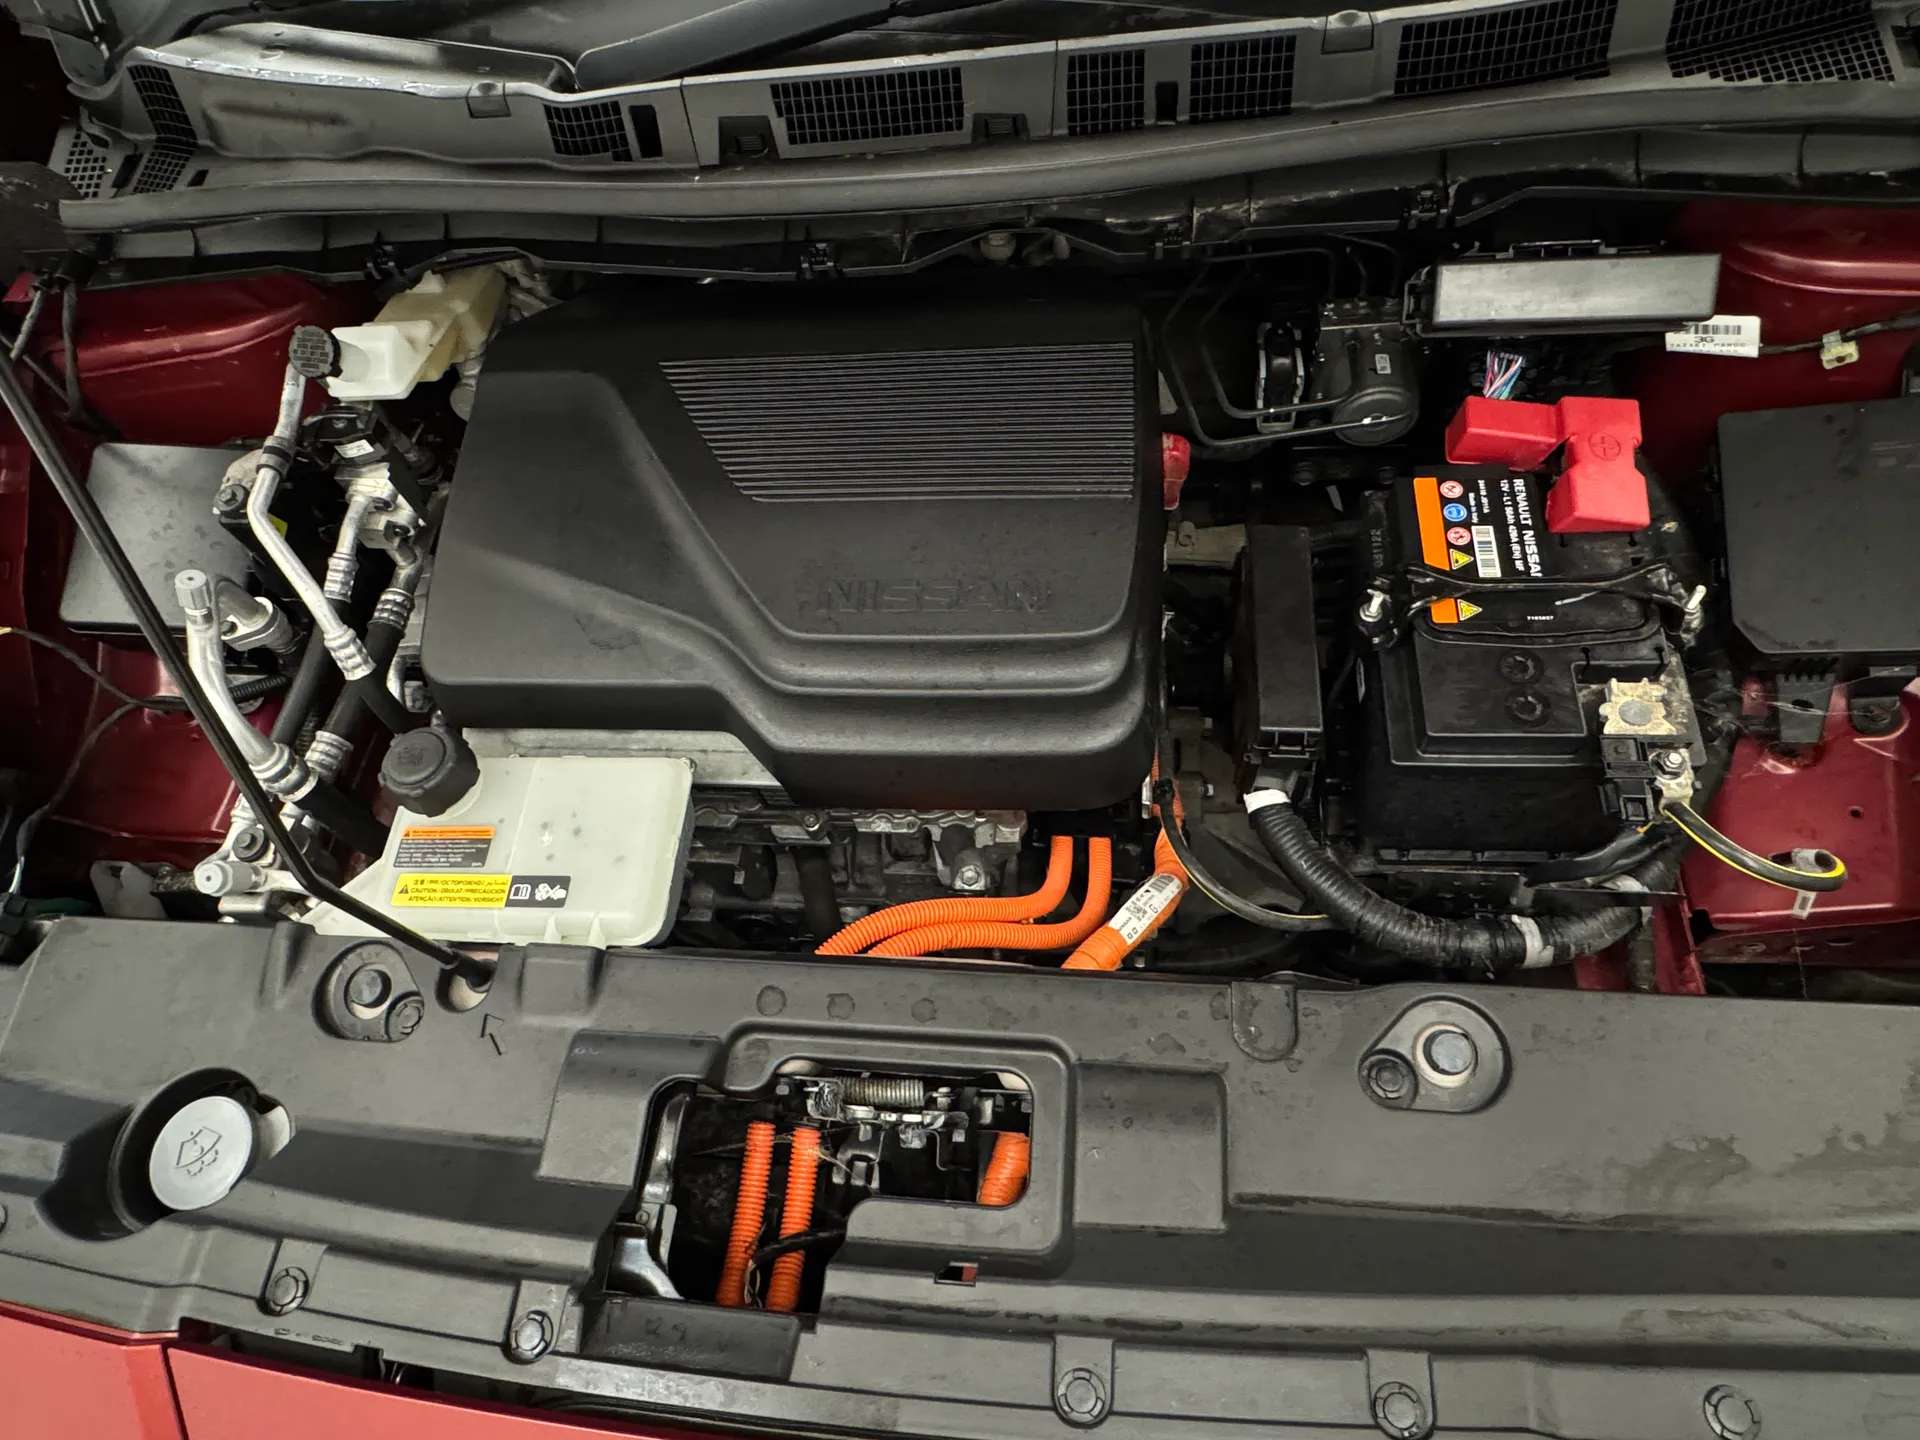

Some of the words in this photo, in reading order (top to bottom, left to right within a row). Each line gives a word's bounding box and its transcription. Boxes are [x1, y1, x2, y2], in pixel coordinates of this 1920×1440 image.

[1500, 480, 1510, 492] 12V
[1513, 479, 1532, 526] RENAULT
[816, 578, 1052, 613] NISSAN
